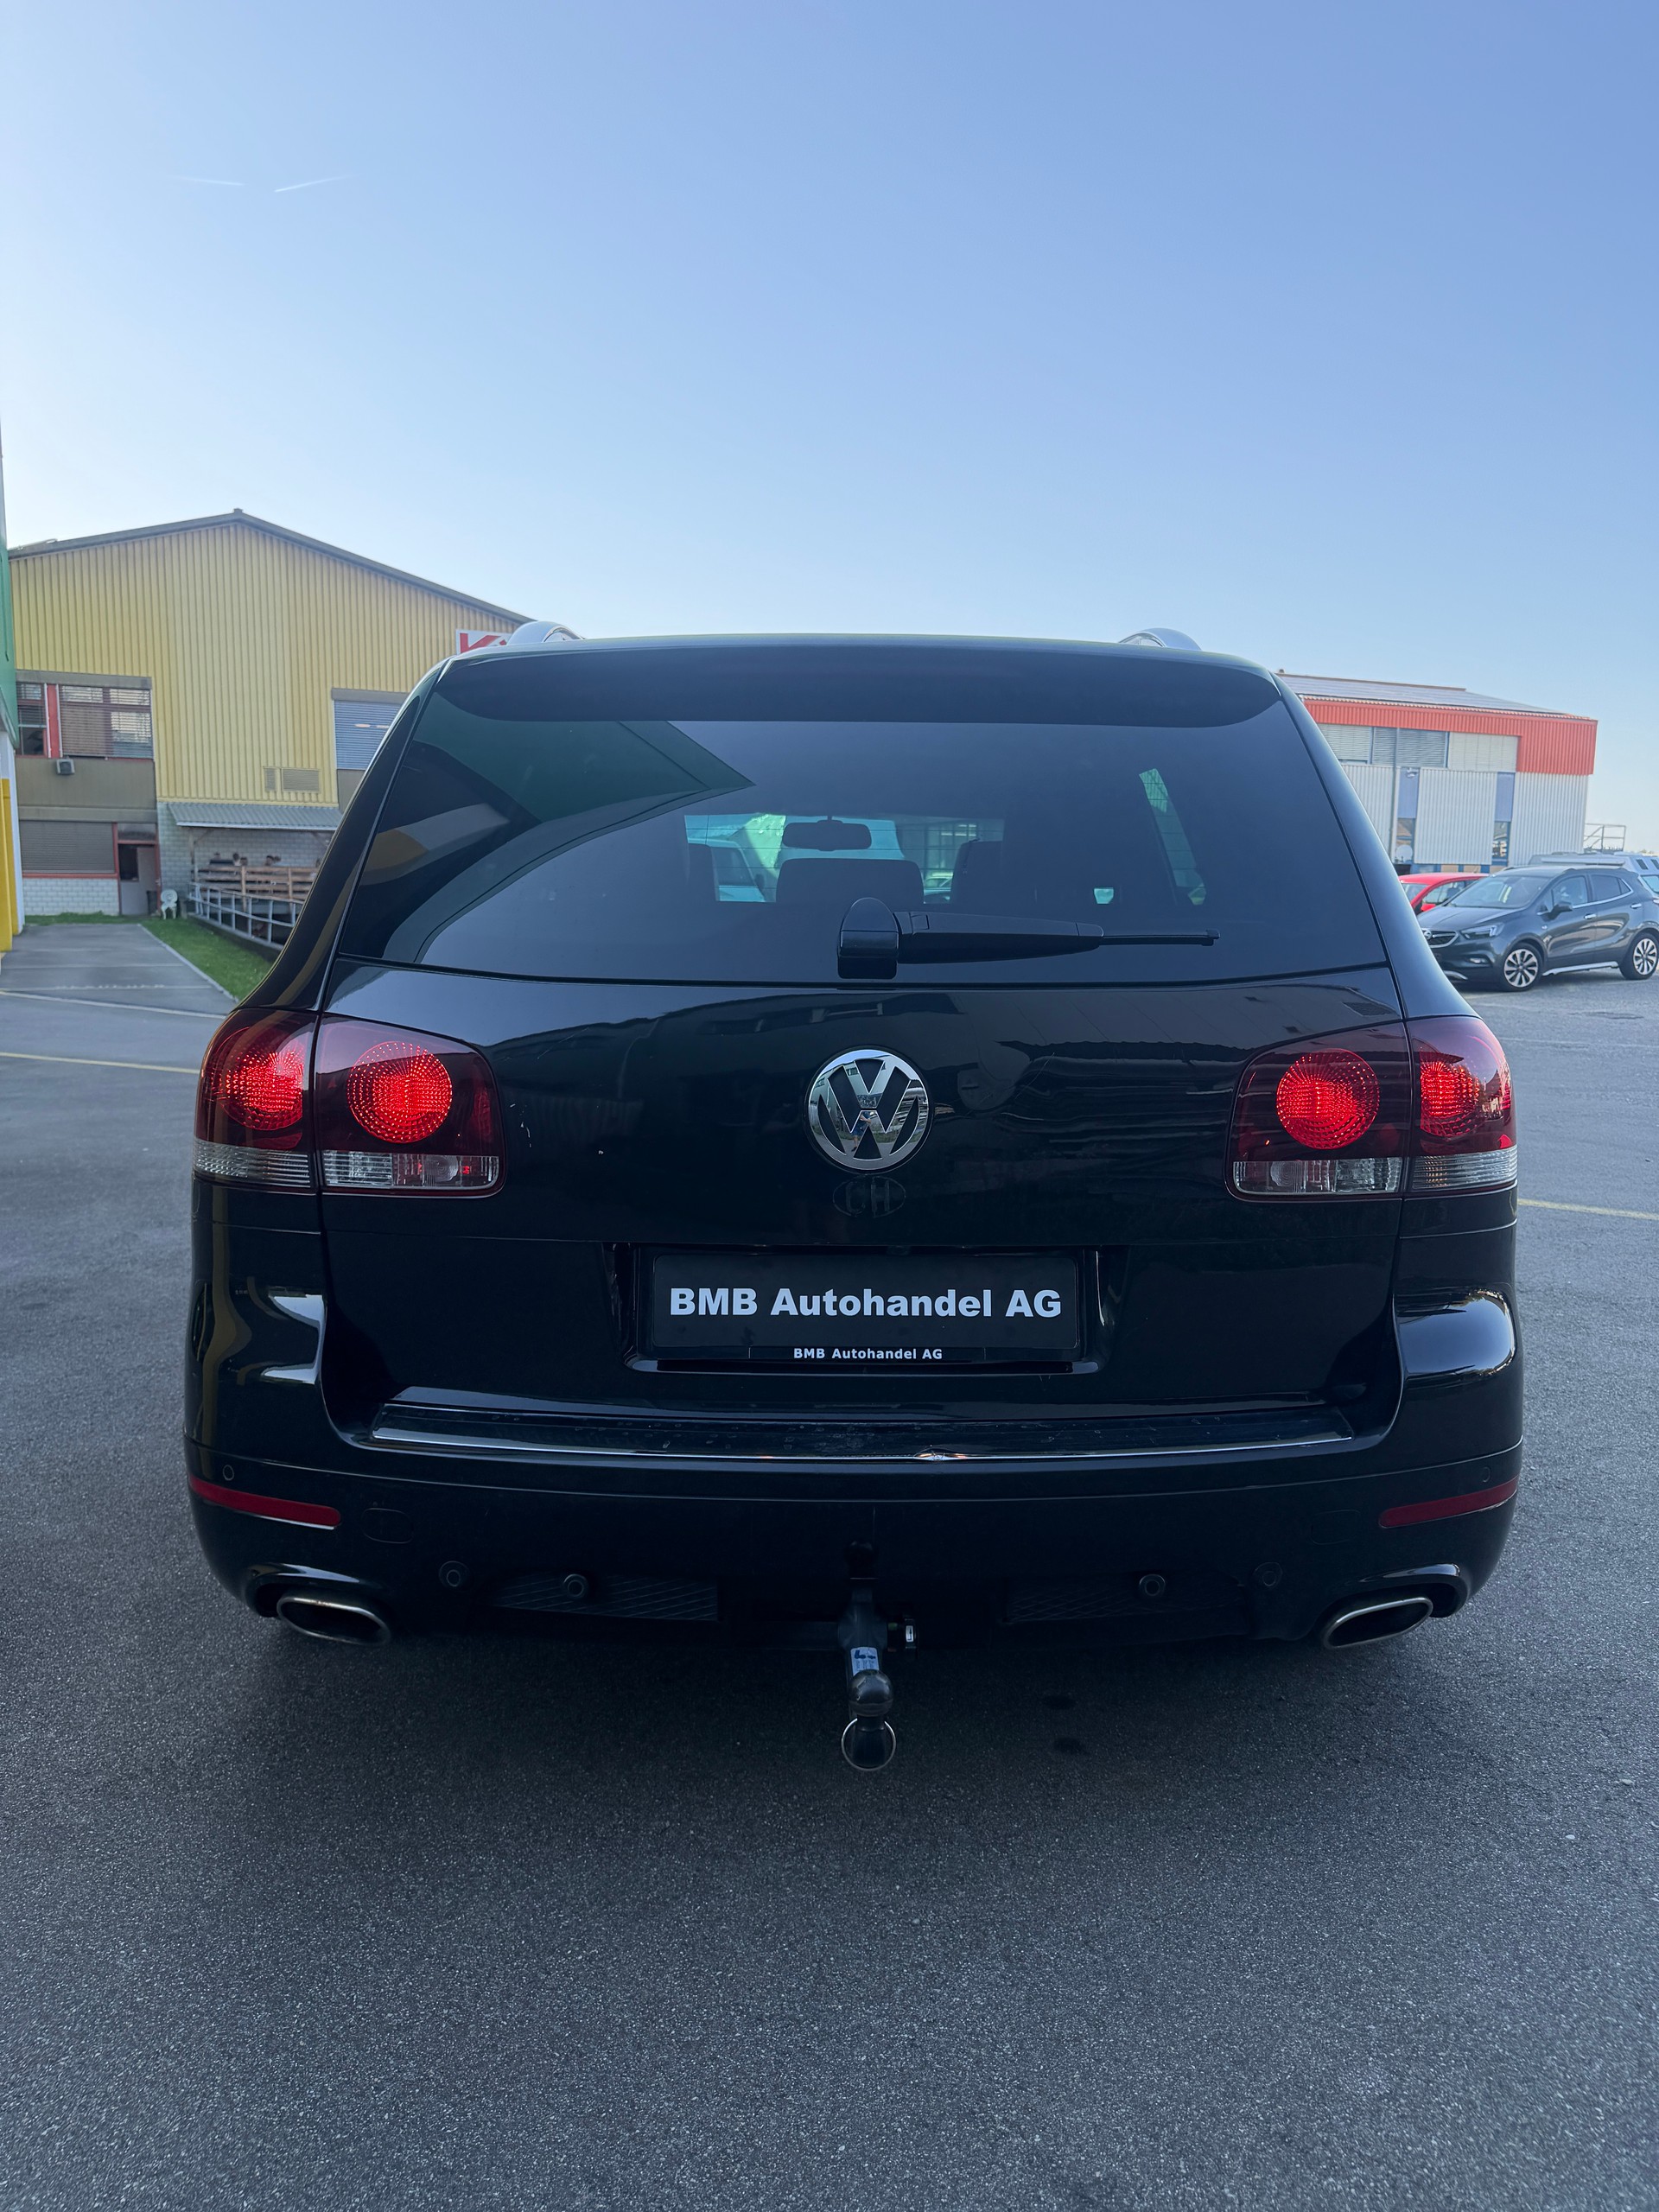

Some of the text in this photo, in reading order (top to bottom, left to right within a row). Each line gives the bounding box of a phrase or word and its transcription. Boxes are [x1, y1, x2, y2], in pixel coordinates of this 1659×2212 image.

[809, 1049, 929, 1171] VW
[670, 1287, 1062, 1318] BMB Autohandel AG
[793, 1347, 943, 1360] BMB Autohandel AG
